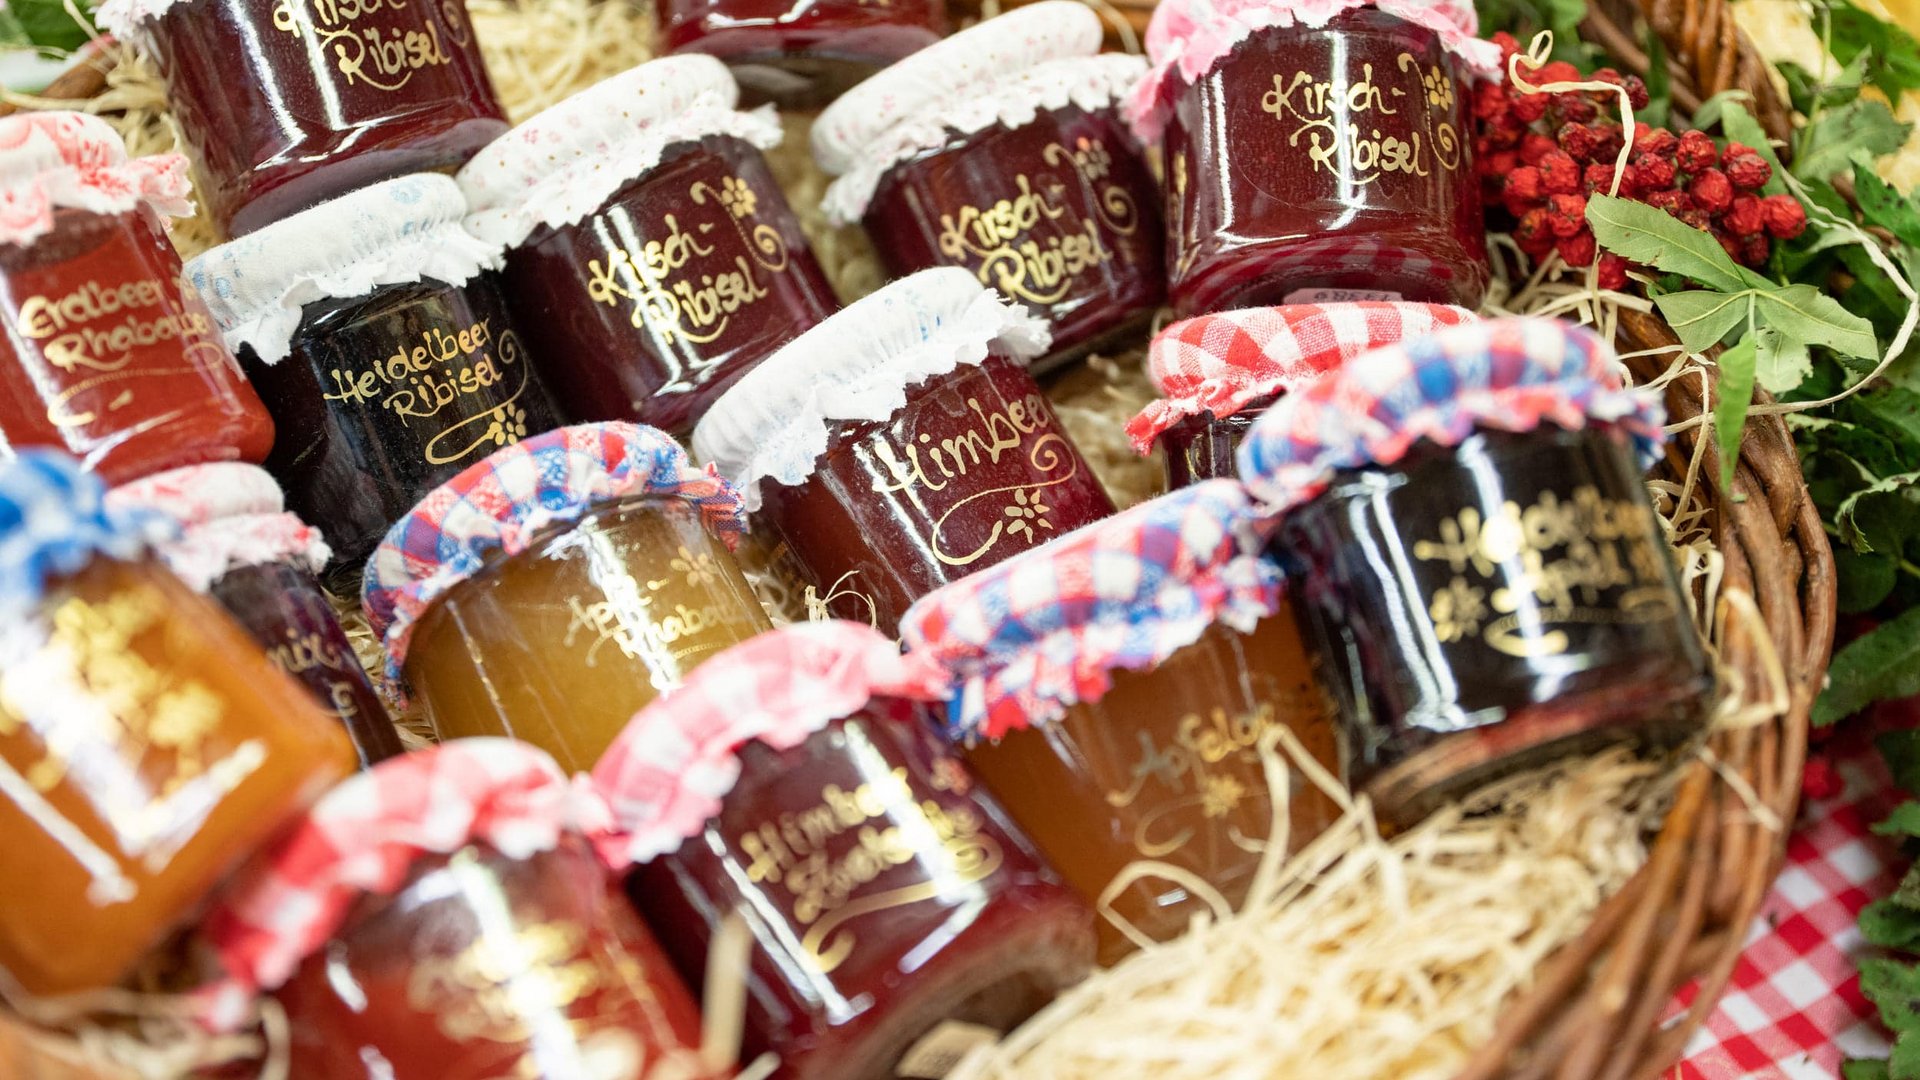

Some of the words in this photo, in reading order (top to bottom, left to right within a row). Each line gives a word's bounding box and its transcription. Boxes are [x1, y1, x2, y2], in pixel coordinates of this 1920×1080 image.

[315, 20, 451, 91] Ribisel
[1262, 62, 1406, 122] Kirsch-
[1289, 122, 1429, 186] Ribisel
[939, 173, 1066, 262] Kirsch-
[588, 213, 715, 307] Kirsch-
[631, 255, 769, 345] Ribisel
[978, 217, 1114, 304] Ribisel
[18, 280, 163, 339] Erdbeer
[323, 317, 491, 404] Heidelbeer
[382, 353, 504, 428] Ribisel
